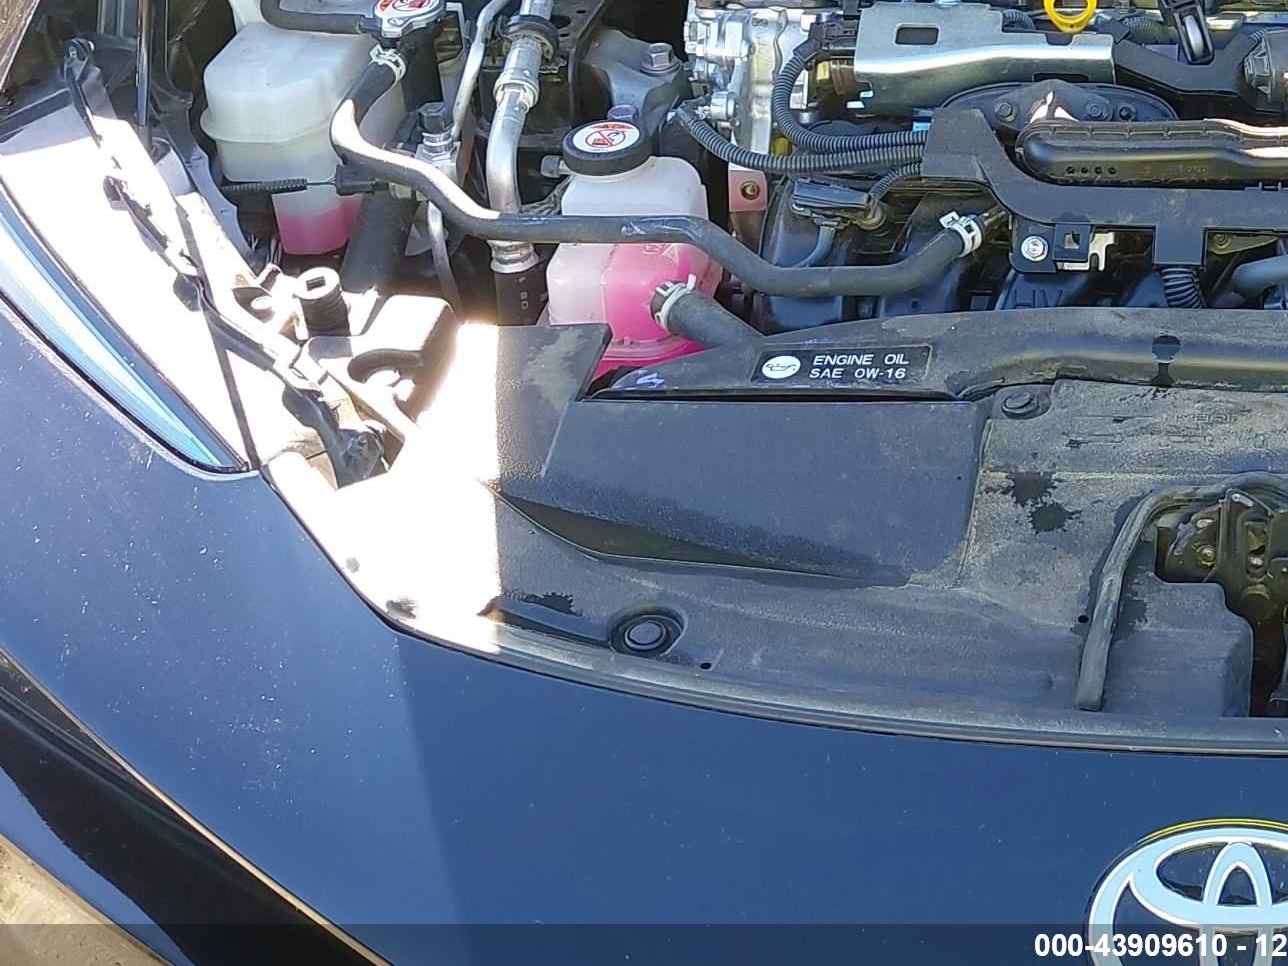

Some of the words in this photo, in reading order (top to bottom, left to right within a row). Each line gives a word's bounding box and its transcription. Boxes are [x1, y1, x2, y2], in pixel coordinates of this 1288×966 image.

[813, 354, 874, 366] ENGINE
[884, 353, 909, 365] OIL
[809, 367, 843, 379] SAE
[854, 368, 906, 379] 0W-16
